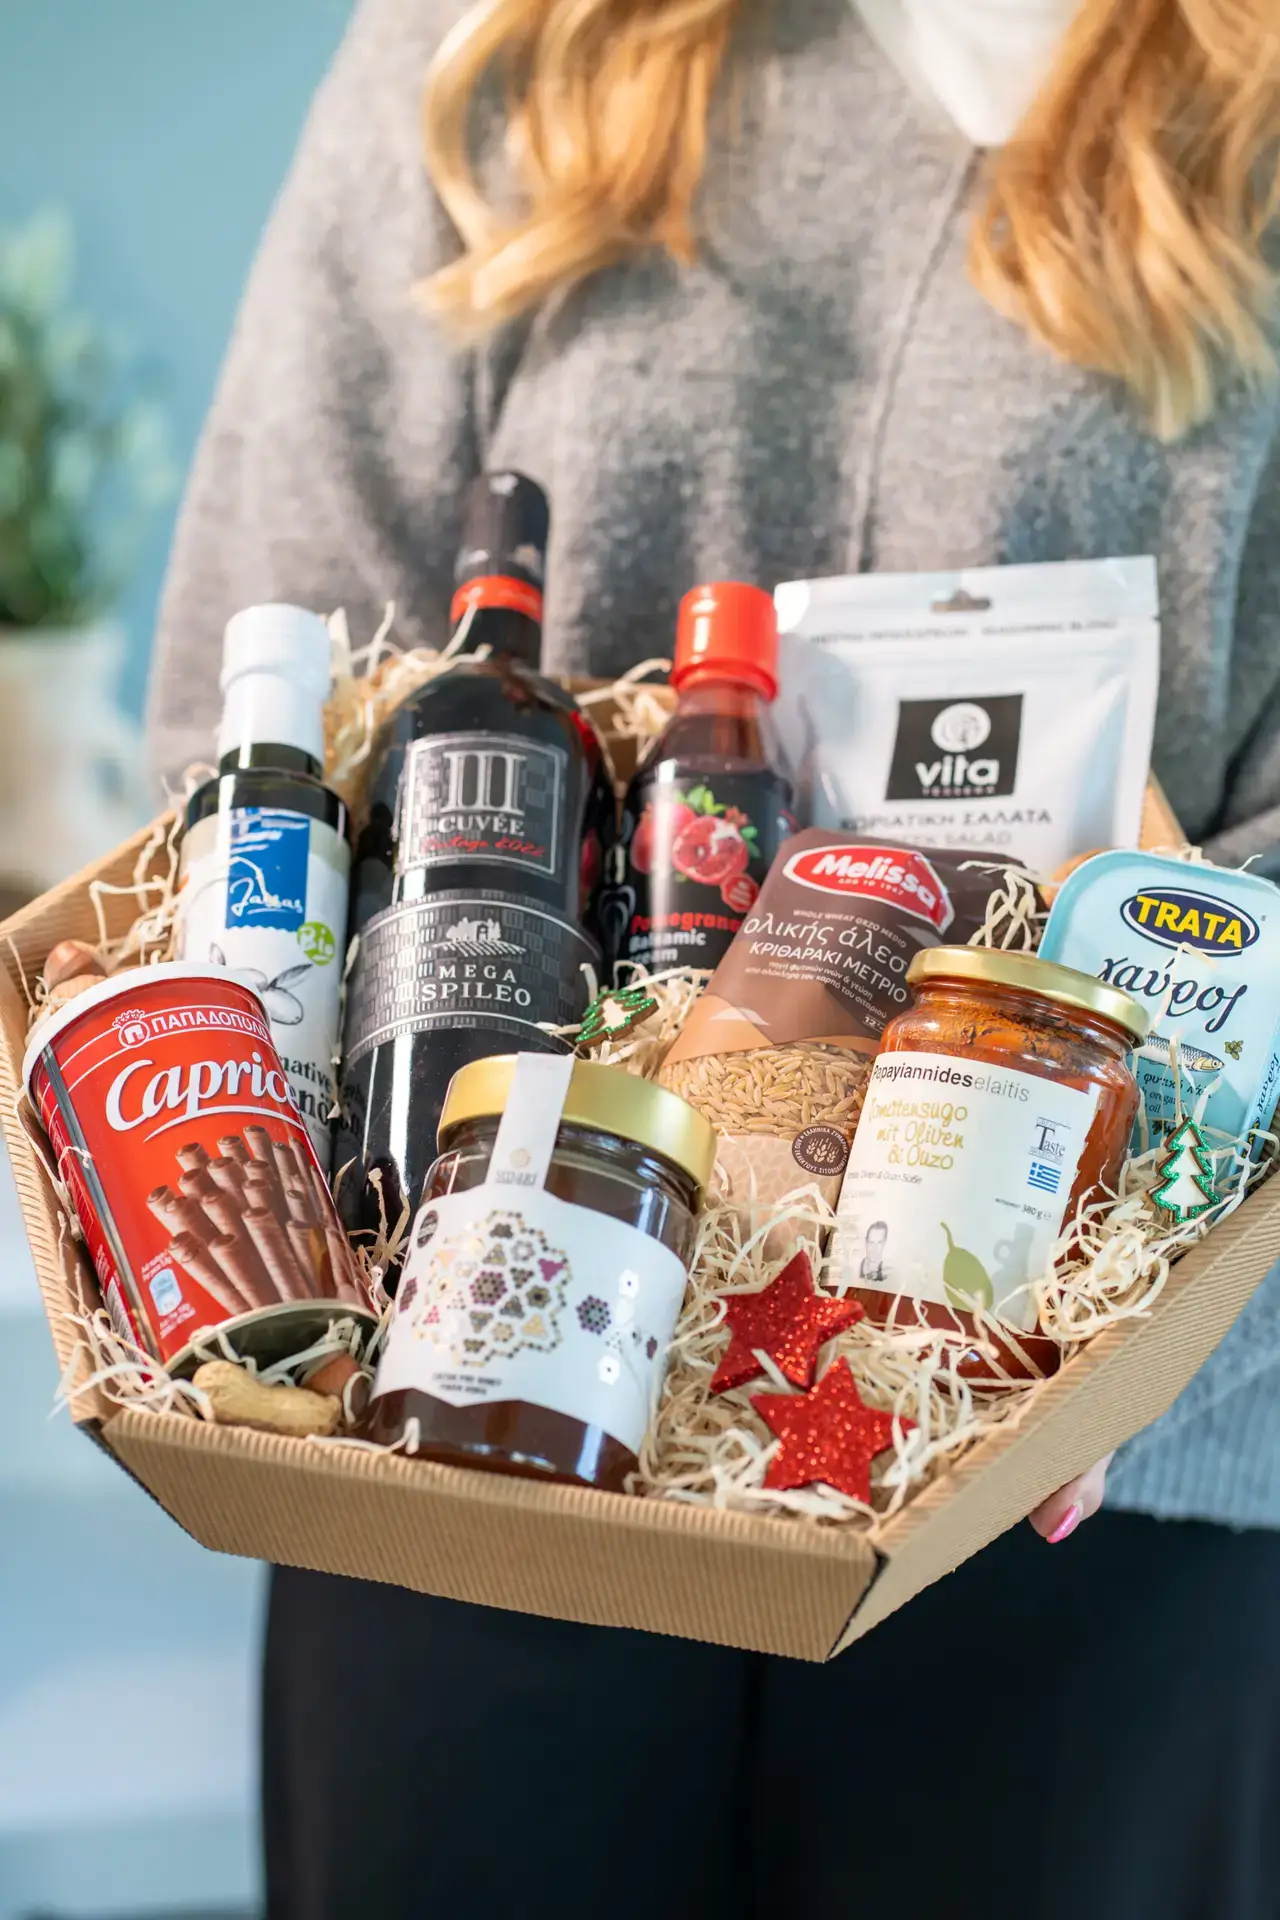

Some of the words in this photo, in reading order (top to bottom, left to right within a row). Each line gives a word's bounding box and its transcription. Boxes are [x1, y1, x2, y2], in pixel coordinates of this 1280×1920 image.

[915, 754, 1000, 787] vita
[811, 853, 937, 909] Melissa
[855, 917, 881, 932] ORZO
[881, 927, 907, 948] MEDIO
[1135, 895, 1244, 949] TRATA
[837, 925, 908, 973] άλεσ
[438, 964, 517, 984] MEGA
[749, 941, 843, 965] ΚΡΙΘΑΡΑΚΙ
[842, 956, 908, 1003] ΜΕΤΡΙΟ
[421, 983, 532, 1006] SPILEO
[905, 1120, 964, 1149] Oliven
[1035, 1123, 1066, 1157] Taste
[906, 1144, 954, 1170] Ouzo
